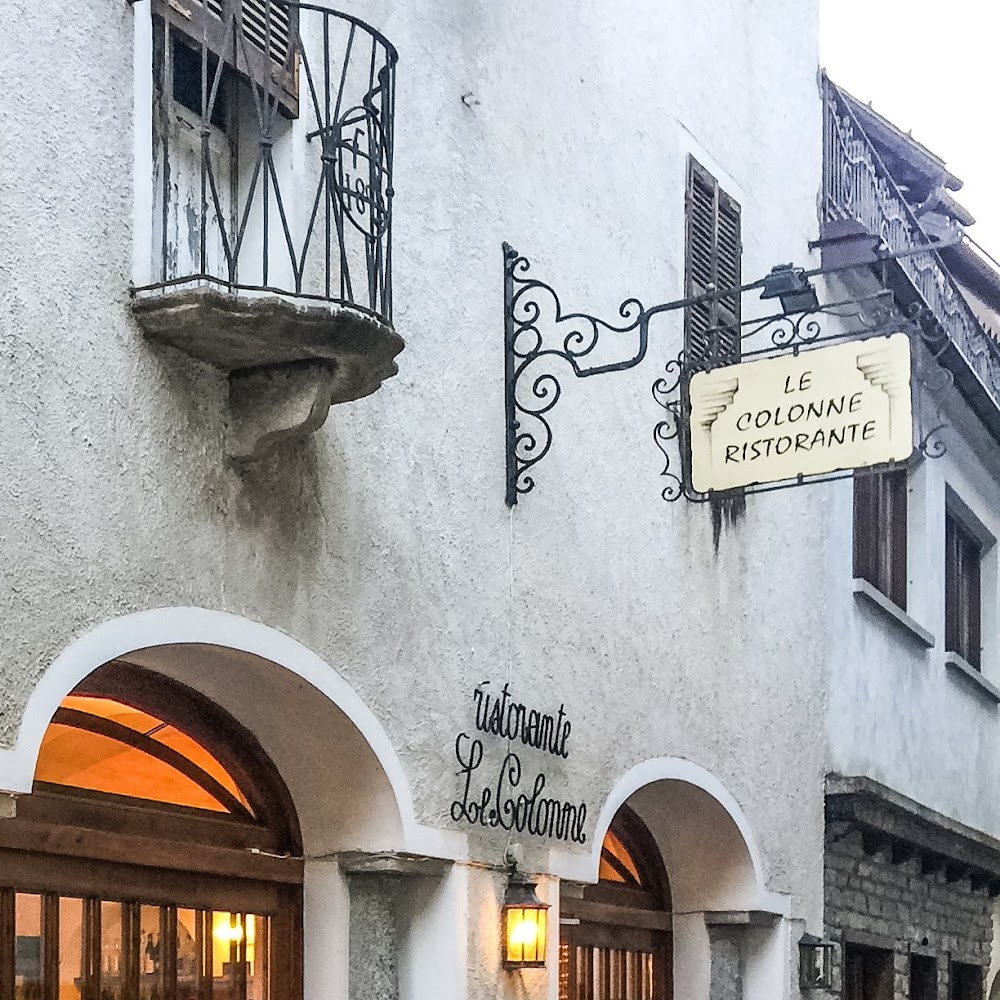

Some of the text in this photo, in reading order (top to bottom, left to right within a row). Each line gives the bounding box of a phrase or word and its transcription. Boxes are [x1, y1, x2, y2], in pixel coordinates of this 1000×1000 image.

[784, 371, 813, 394] LE
[736, 392, 863, 431] COLONNE
[725, 420, 876, 464] RISTORANTE
